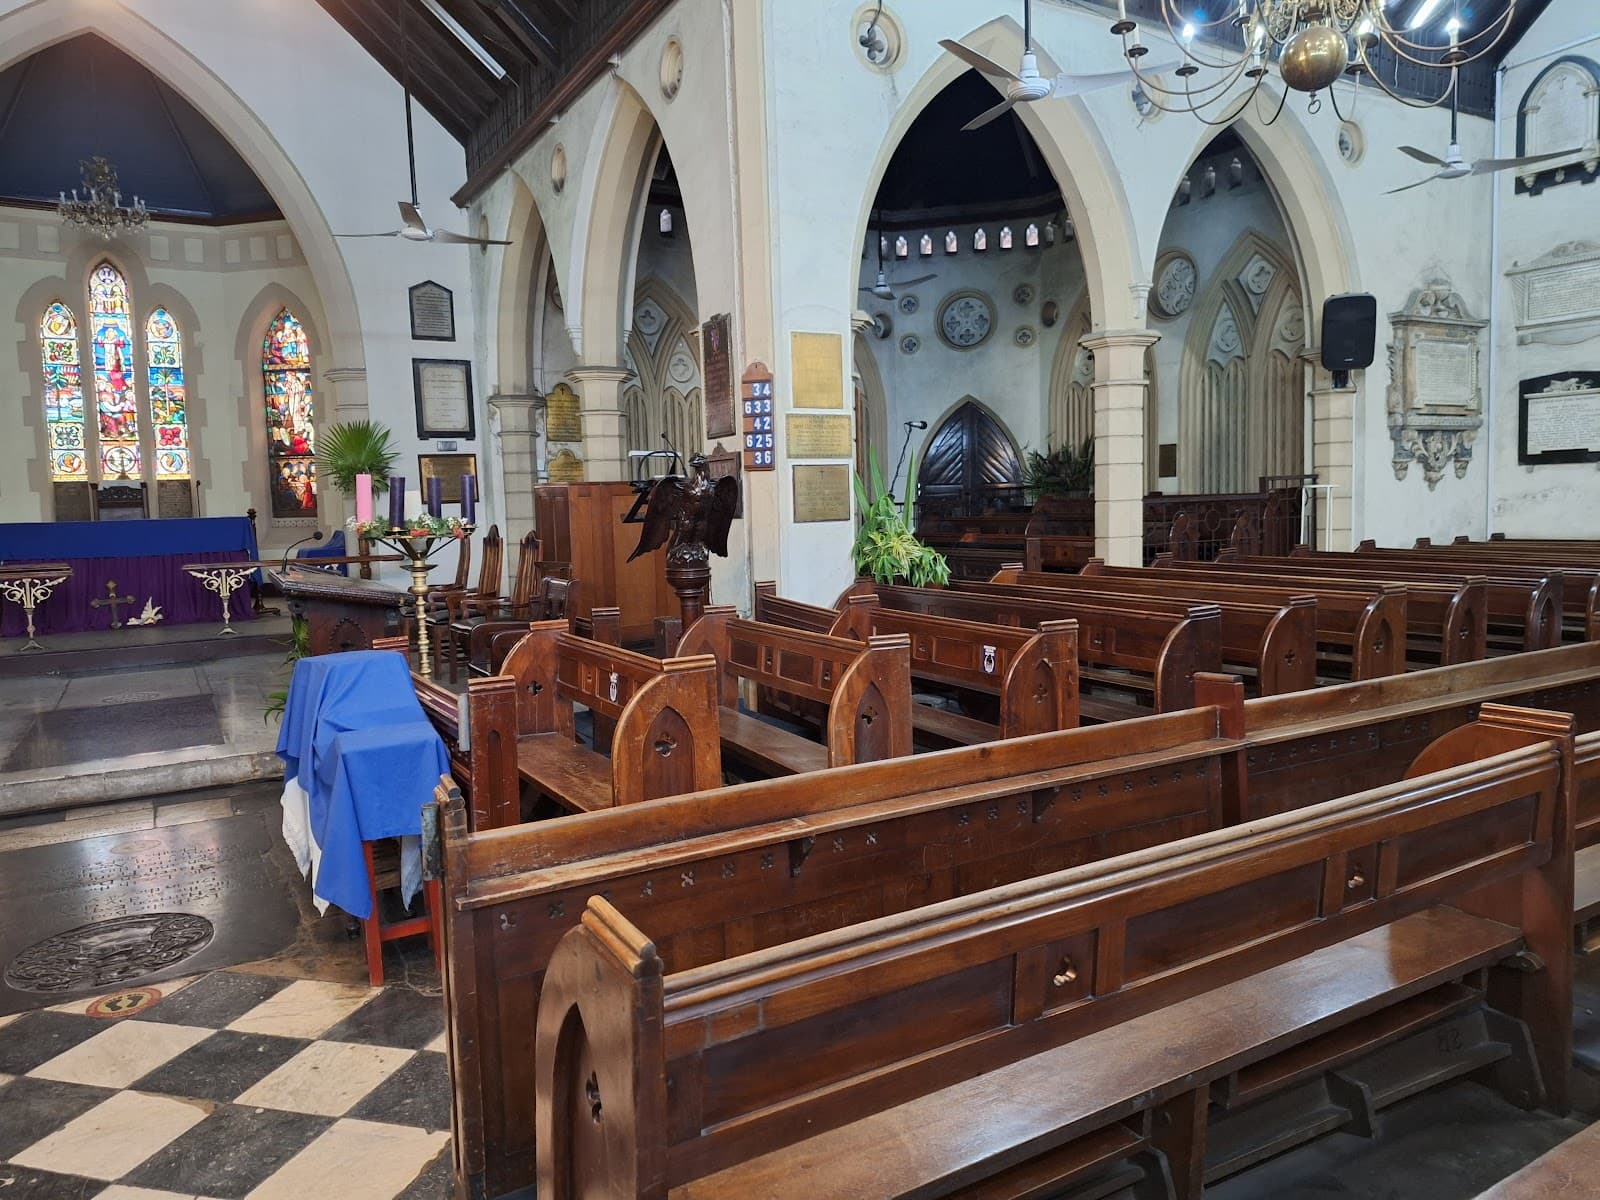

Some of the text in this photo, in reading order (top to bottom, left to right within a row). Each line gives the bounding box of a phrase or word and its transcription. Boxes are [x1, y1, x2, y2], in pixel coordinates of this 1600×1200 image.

[753, 382, 771, 396] 34
[744, 400, 771, 414] 633
[754, 417, 771, 430] 42
[746, 434, 773, 448] 625
[754, 450, 772, 464] 36
